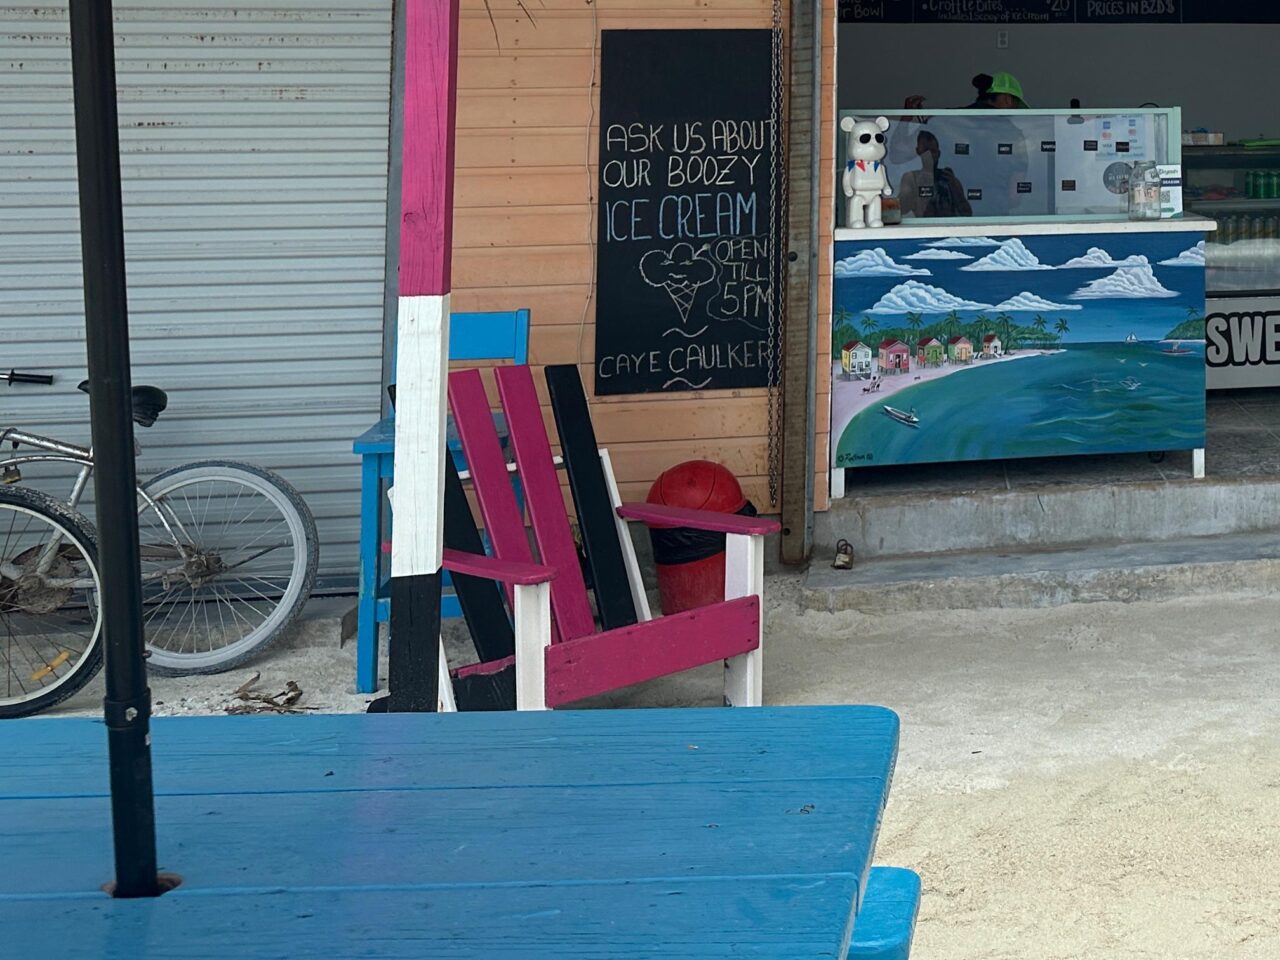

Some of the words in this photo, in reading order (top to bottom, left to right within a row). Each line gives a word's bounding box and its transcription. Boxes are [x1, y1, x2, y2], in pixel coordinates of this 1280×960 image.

[853, 2, 885, 20] Bowl
[1086, 0, 1124, 17] PRICES
[1125, 0, 1140, 15] IN
[606, 123, 665, 153] ASK
[673, 121, 707, 155] US
[712, 118, 773, 152] ABOUT
[602, 158, 652, 188] OUR
[667, 153, 762, 188] BOOZY
[605, 198, 653, 243] ICE
[658, 191, 758, 241] CREAM
[715, 239, 769, 264] OPEN
[722, 261, 770, 282] TILL
[599, 350, 663, 378] CAYE
[668, 339, 772, 374] CAULKER
